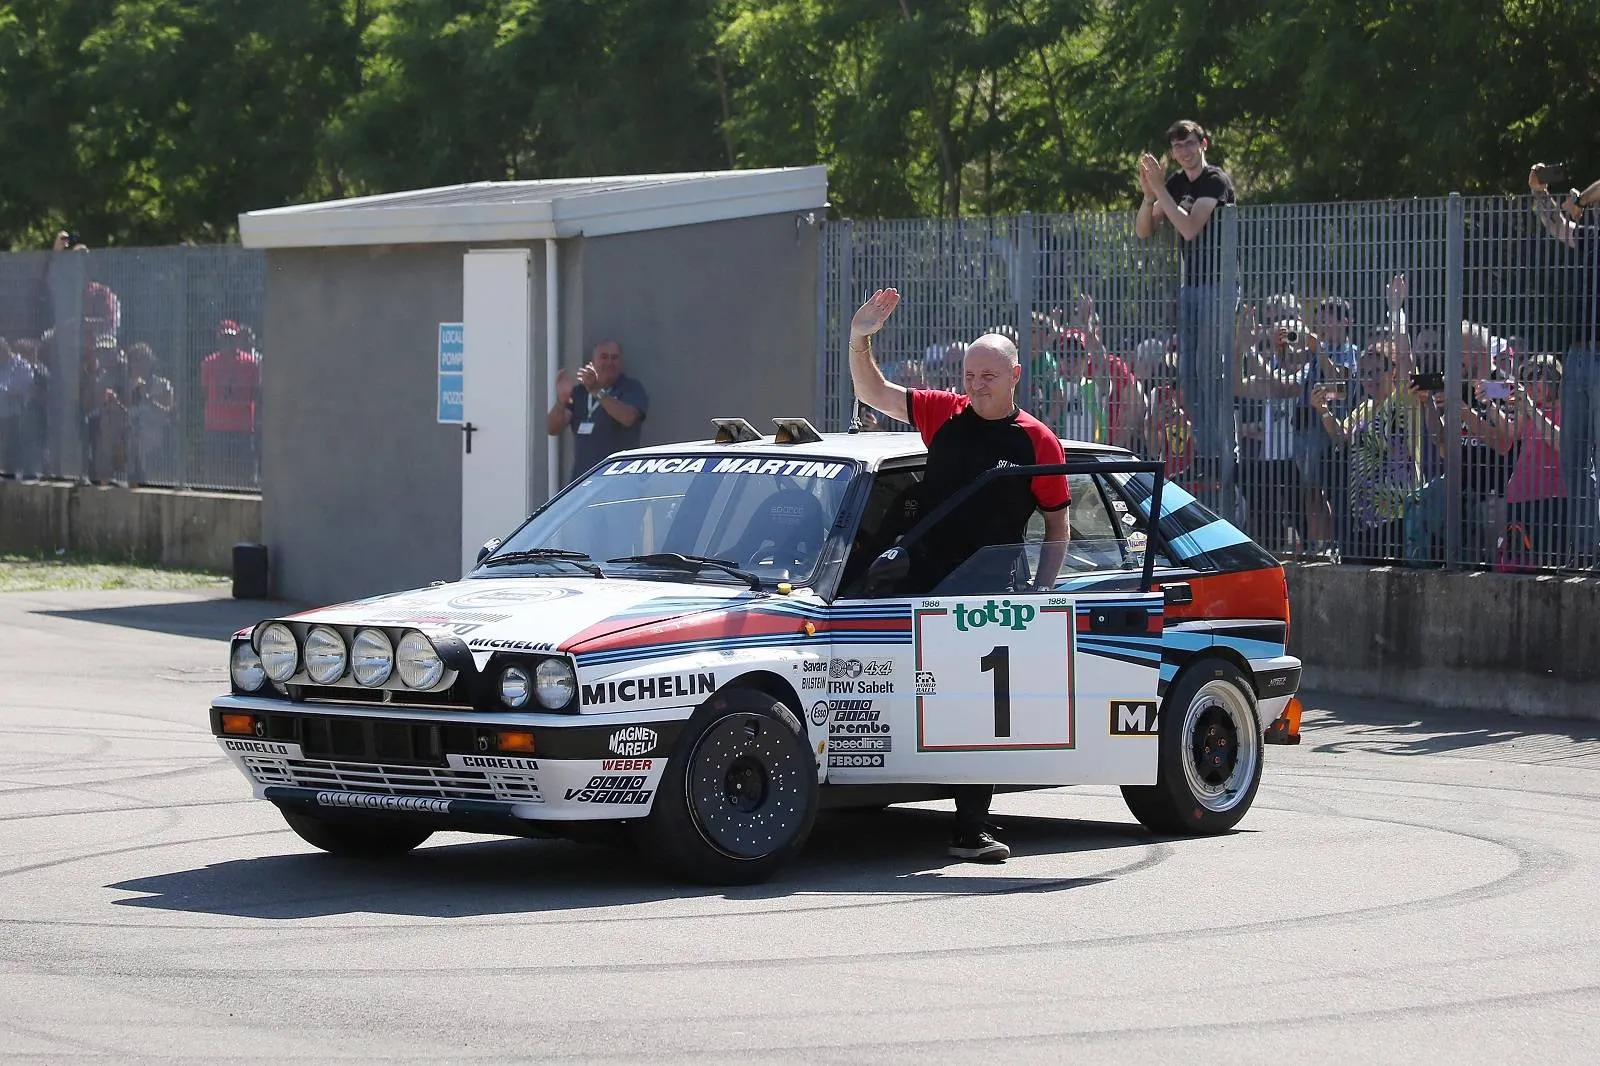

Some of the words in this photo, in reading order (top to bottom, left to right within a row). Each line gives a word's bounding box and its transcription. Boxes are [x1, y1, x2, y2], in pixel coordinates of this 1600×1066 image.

[603, 459, 705, 475] LANCIA
[712, 459, 845, 479] MARTINI
[921, 600, 940, 608] 1988
[953, 600, 1035, 631] totip
[469, 638, 556, 651] MICHELIN
[803, 660, 828, 672] Savara
[864, 660, 892, 675] 4x4
[582, 673, 716, 705] MICHELIN
[802, 677, 826, 690] BILSTEIN
[828, 681, 854, 693] TRW
[858, 681, 894, 694] Sabelt
[980, 646, 1010, 737] 1
[829, 700, 871, 710] OLIO
[814, 707, 827, 718] Esso
[835, 711, 879, 721] FIAT
[829, 722, 890, 733] brembo
[609, 727, 657, 746] MAGNETI
[225, 741, 288, 754] CARELLO
[829, 738, 884, 750] speedline
[463, 757, 539, 770] CARELLO
[602, 760, 652, 770] WEBER
[829, 756, 881, 766] FERODO
[588, 777, 645, 789] OLIO
[594, 791, 650, 803] FIAT
